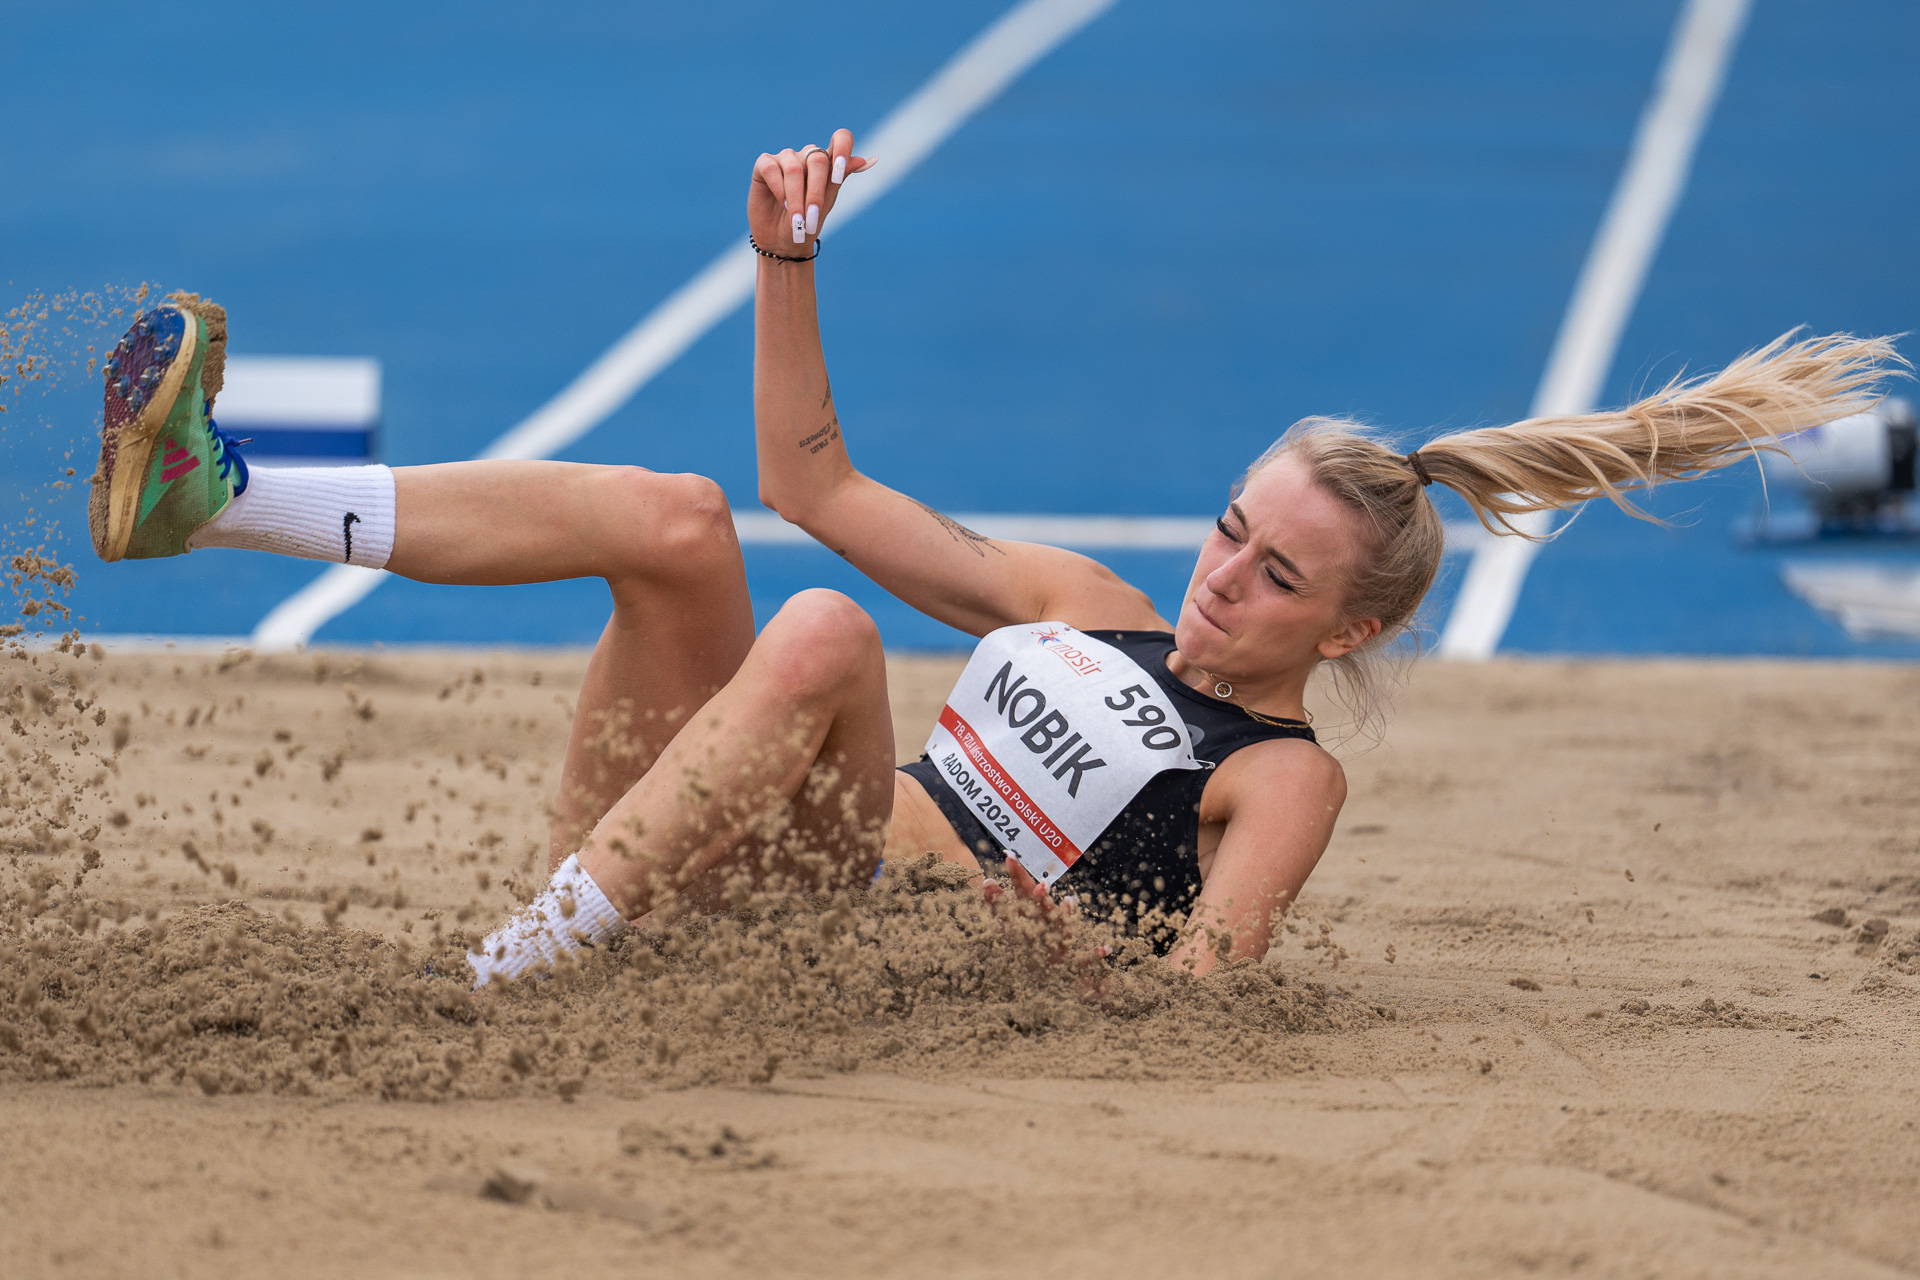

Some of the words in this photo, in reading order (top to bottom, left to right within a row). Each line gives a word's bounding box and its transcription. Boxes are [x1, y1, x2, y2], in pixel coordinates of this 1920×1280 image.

[1050, 643, 1102, 675] mosir
[984, 660, 1107, 799] NOBIK
[1104, 684, 1181, 750] 590
[942, 752, 983, 800] RADOM
[976, 795, 1020, 842] 2024
[953, 720, 966, 739] 78.
[1009, 792, 1043, 826] Polski
[1040, 823, 1062, 848] U20
